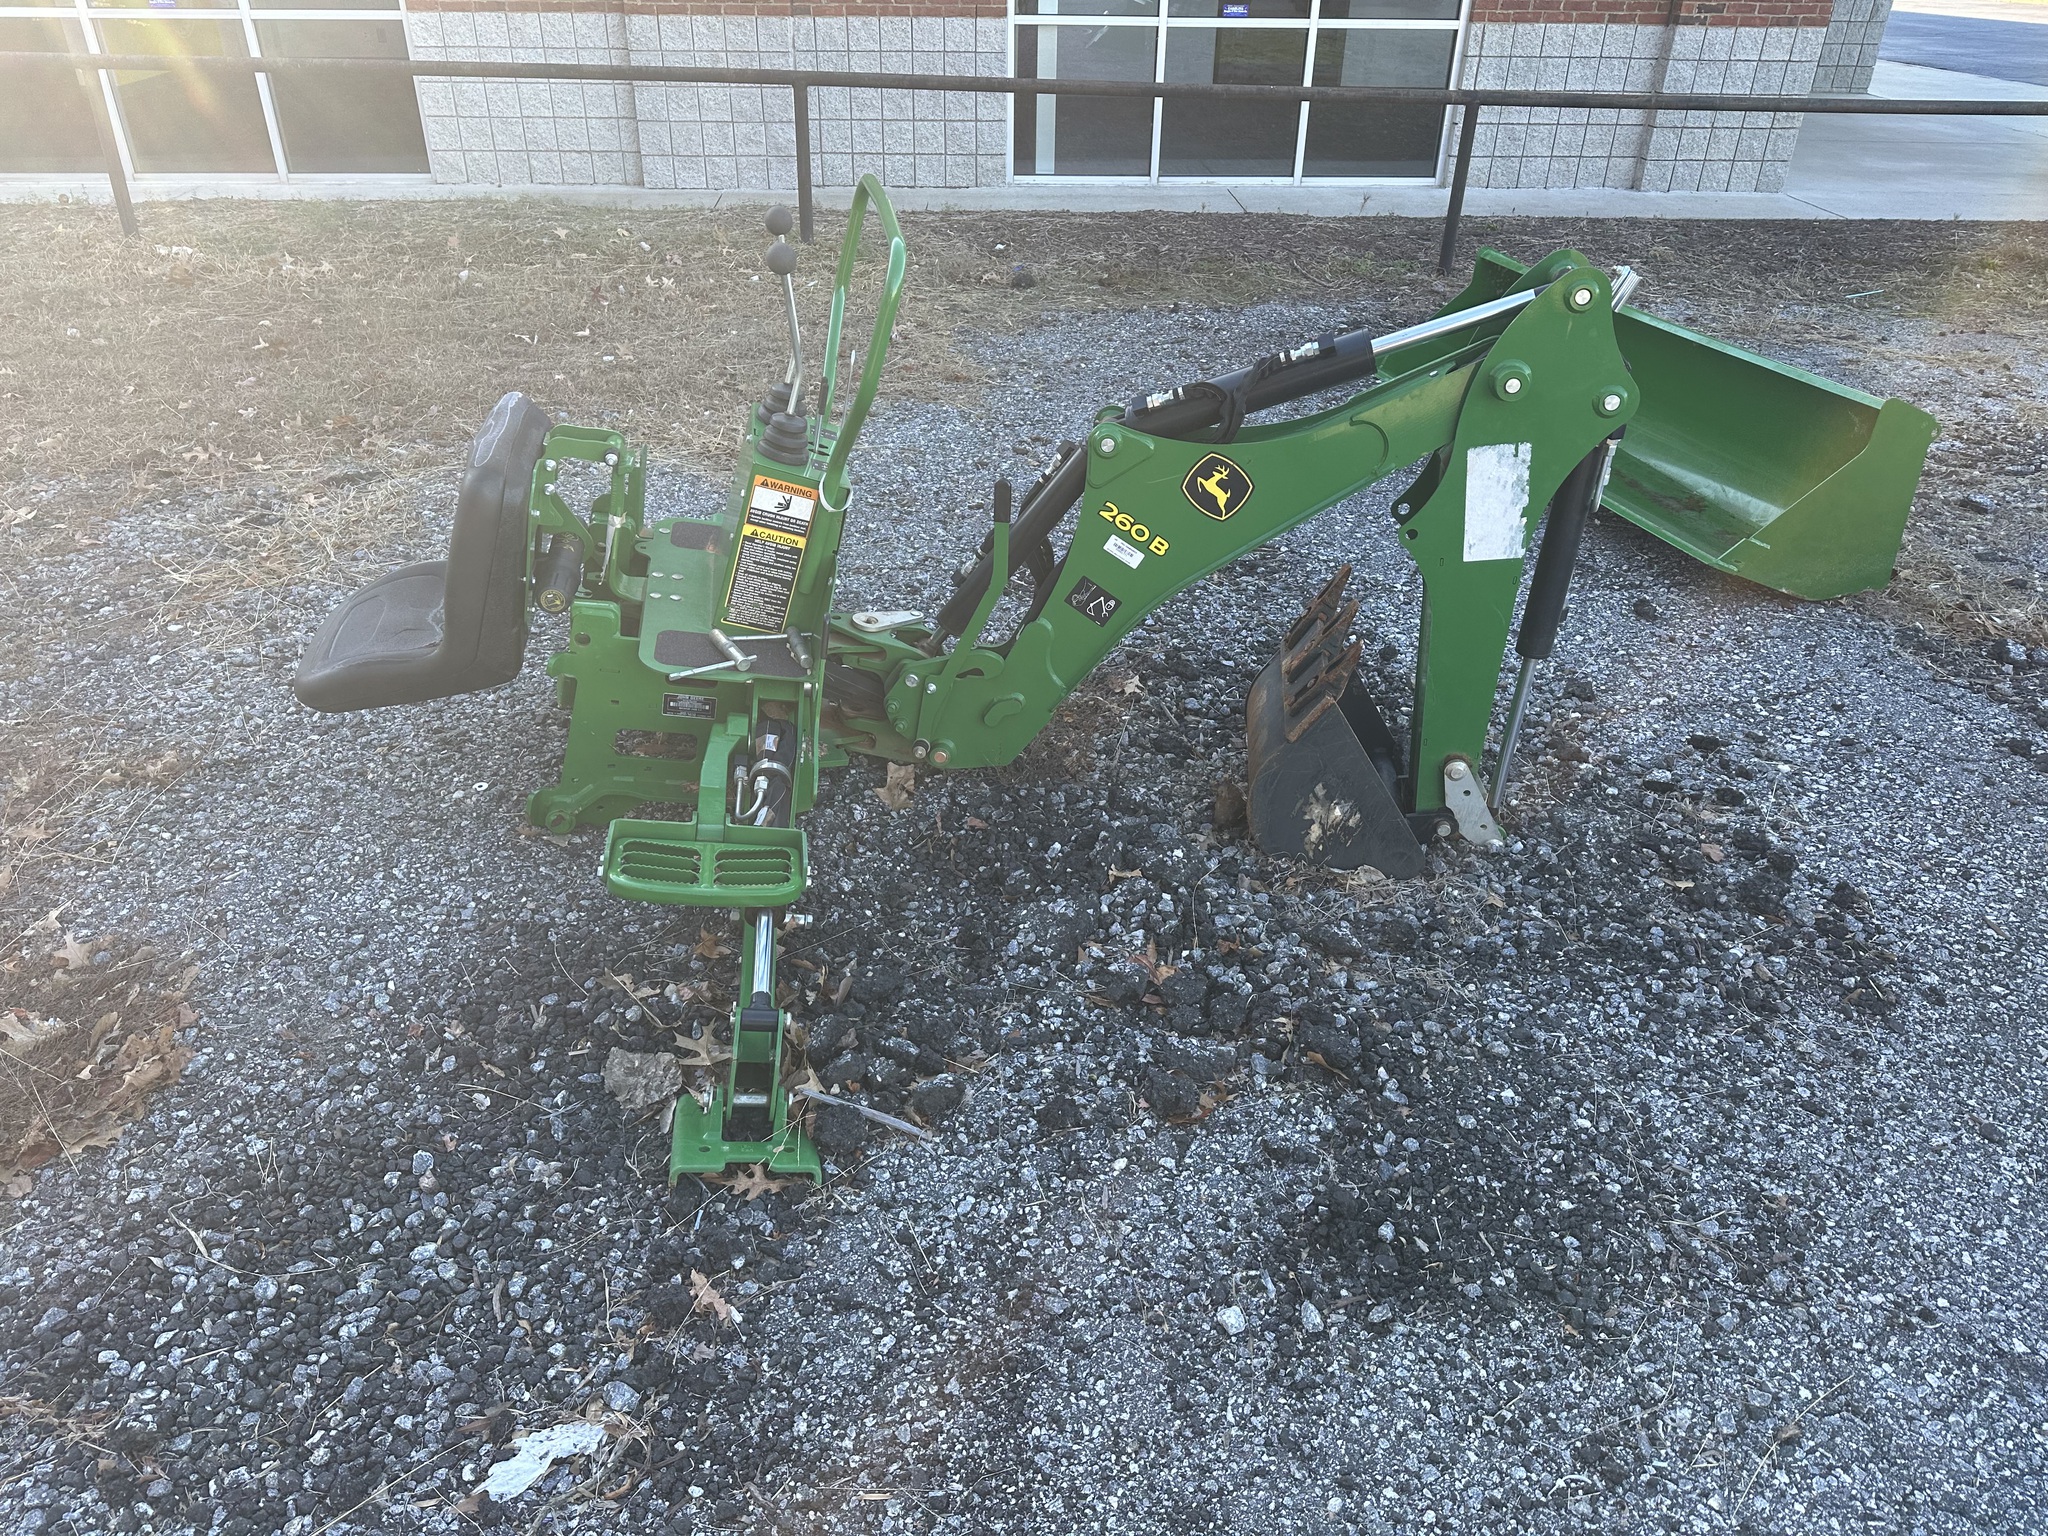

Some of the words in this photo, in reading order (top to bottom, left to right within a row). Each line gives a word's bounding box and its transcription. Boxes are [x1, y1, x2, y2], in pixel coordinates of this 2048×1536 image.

[770, 481, 812, 498] WARNING
[1098, 500, 1151, 543] 260
[1147, 534, 1171, 557] B
[760, 532, 798, 546] CAUTION
